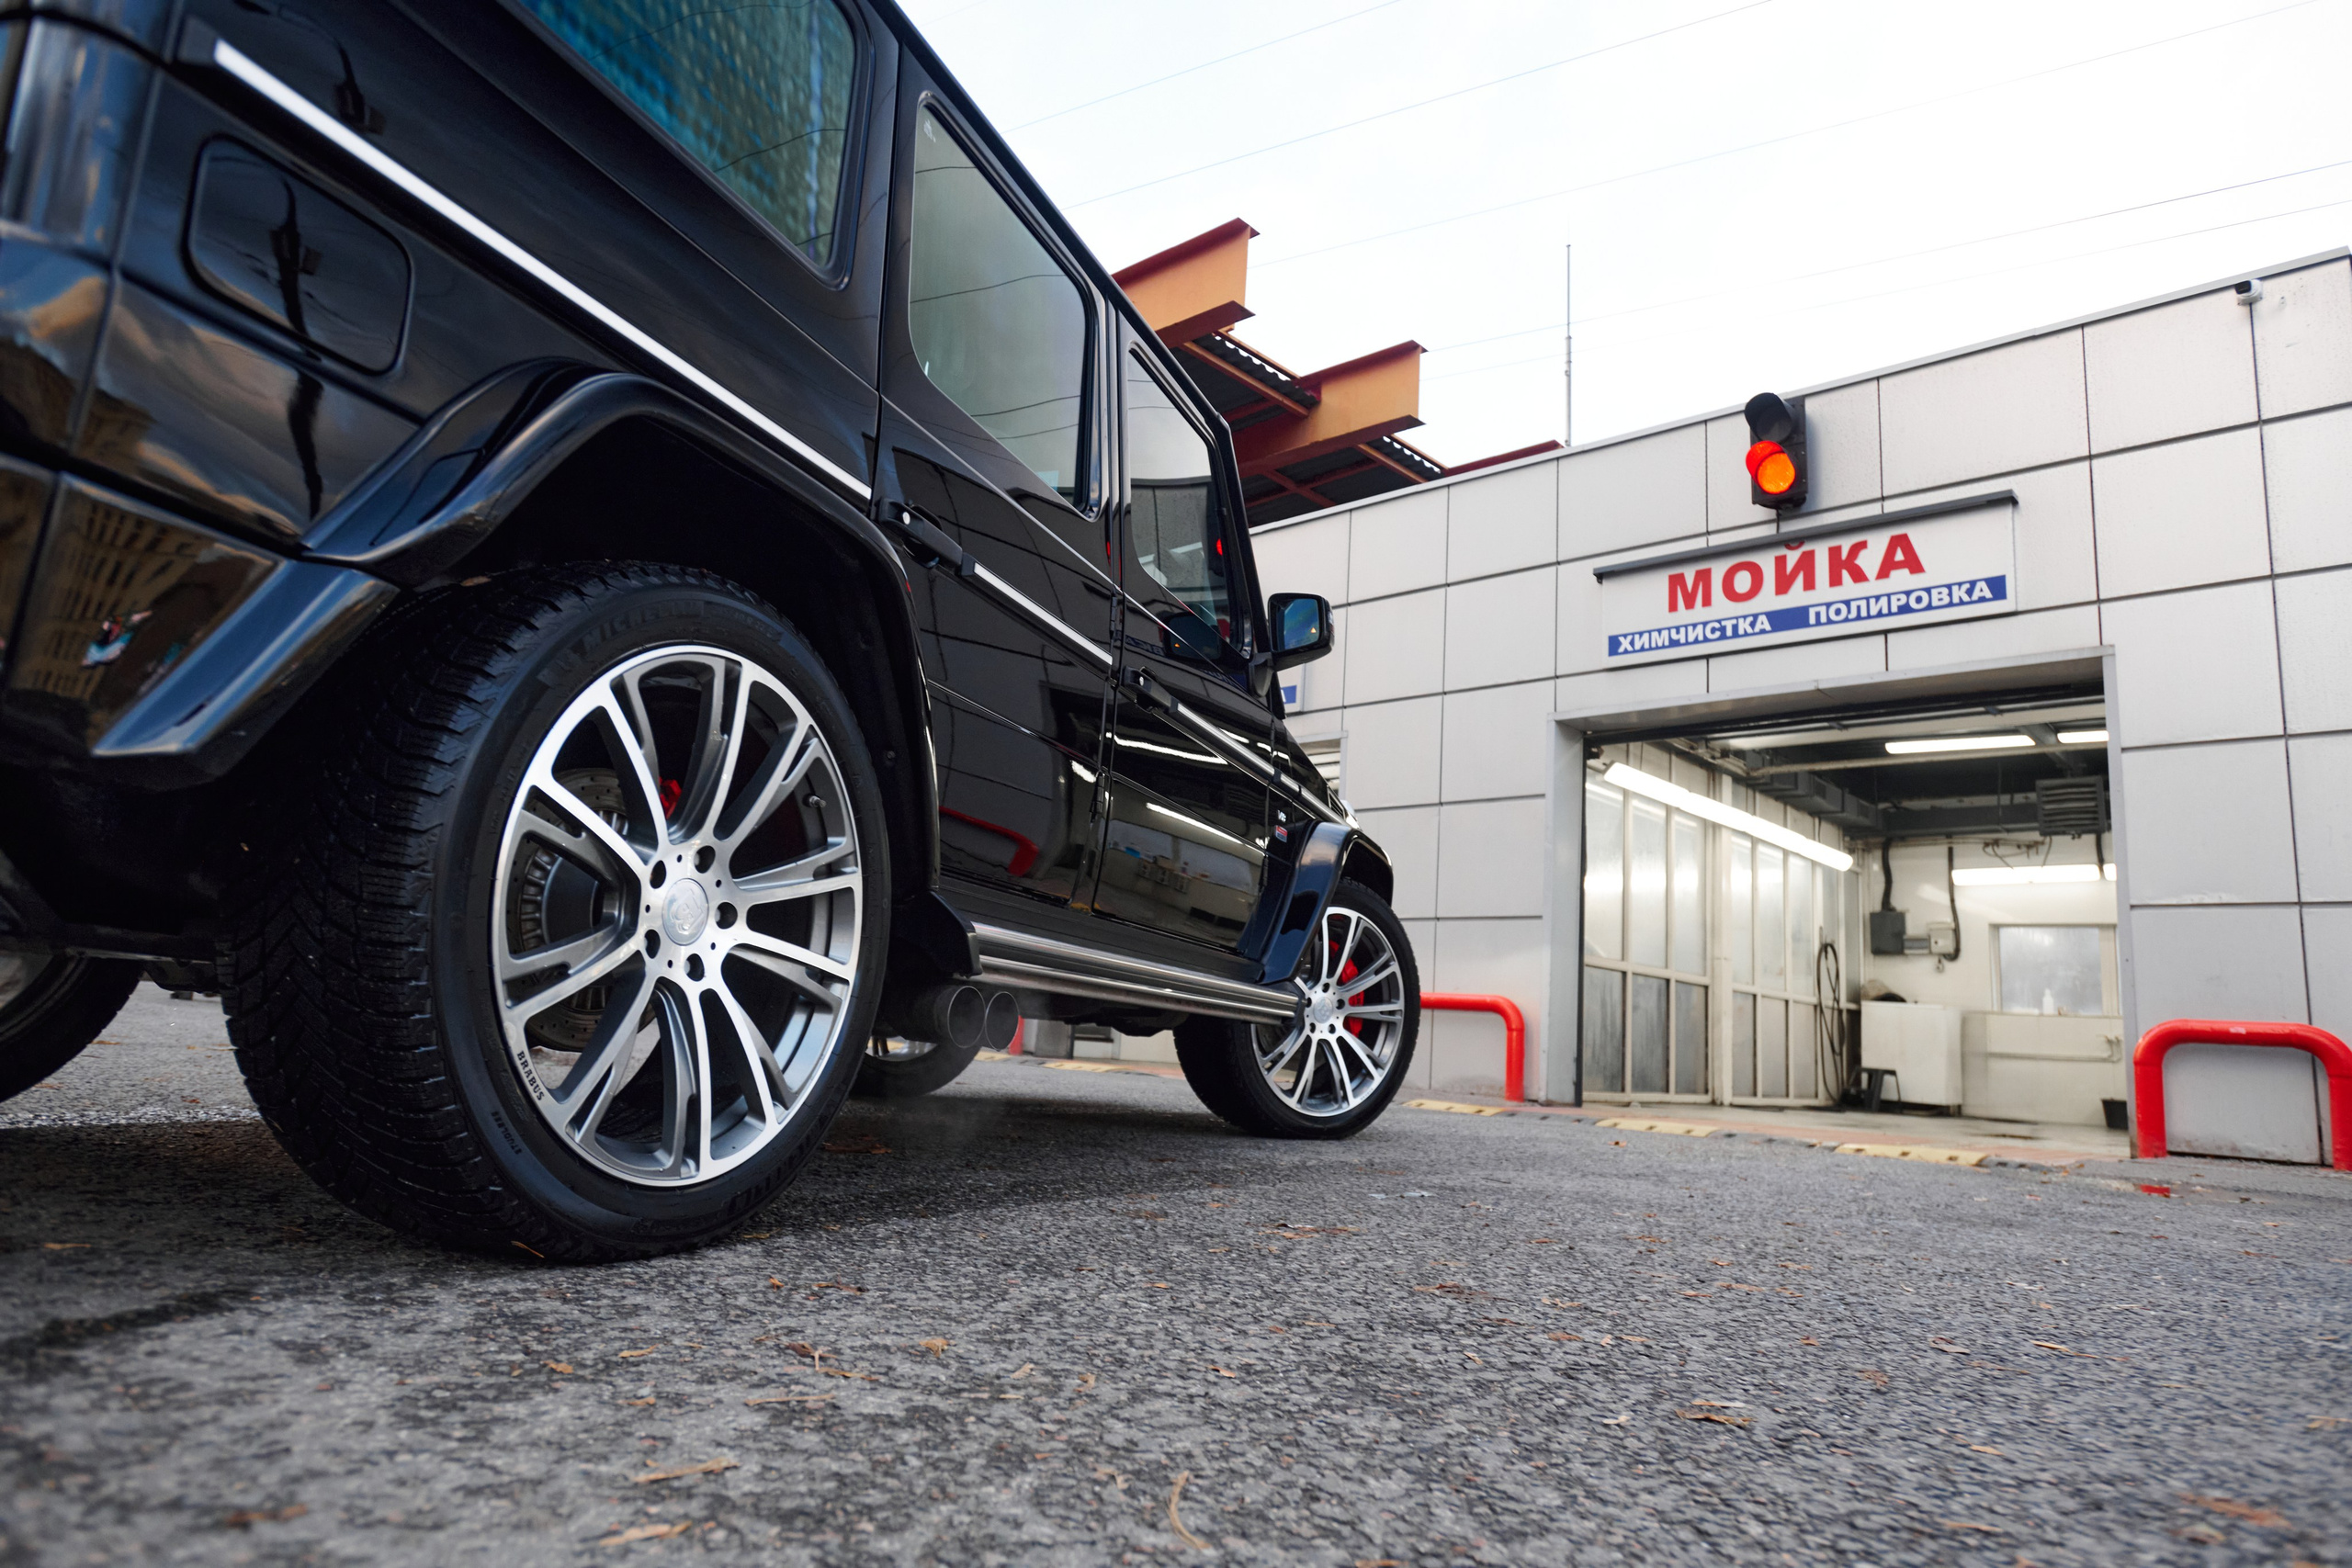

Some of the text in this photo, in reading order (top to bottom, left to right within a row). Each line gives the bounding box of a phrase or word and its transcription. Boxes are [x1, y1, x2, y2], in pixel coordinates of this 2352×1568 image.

[1668, 532, 1926, 613] МОЙКА
[1617, 580, 1993, 653] ХИМЧИСТКА ПОЛИРОВКА
[517, 1050, 545, 1100] BRABUS
